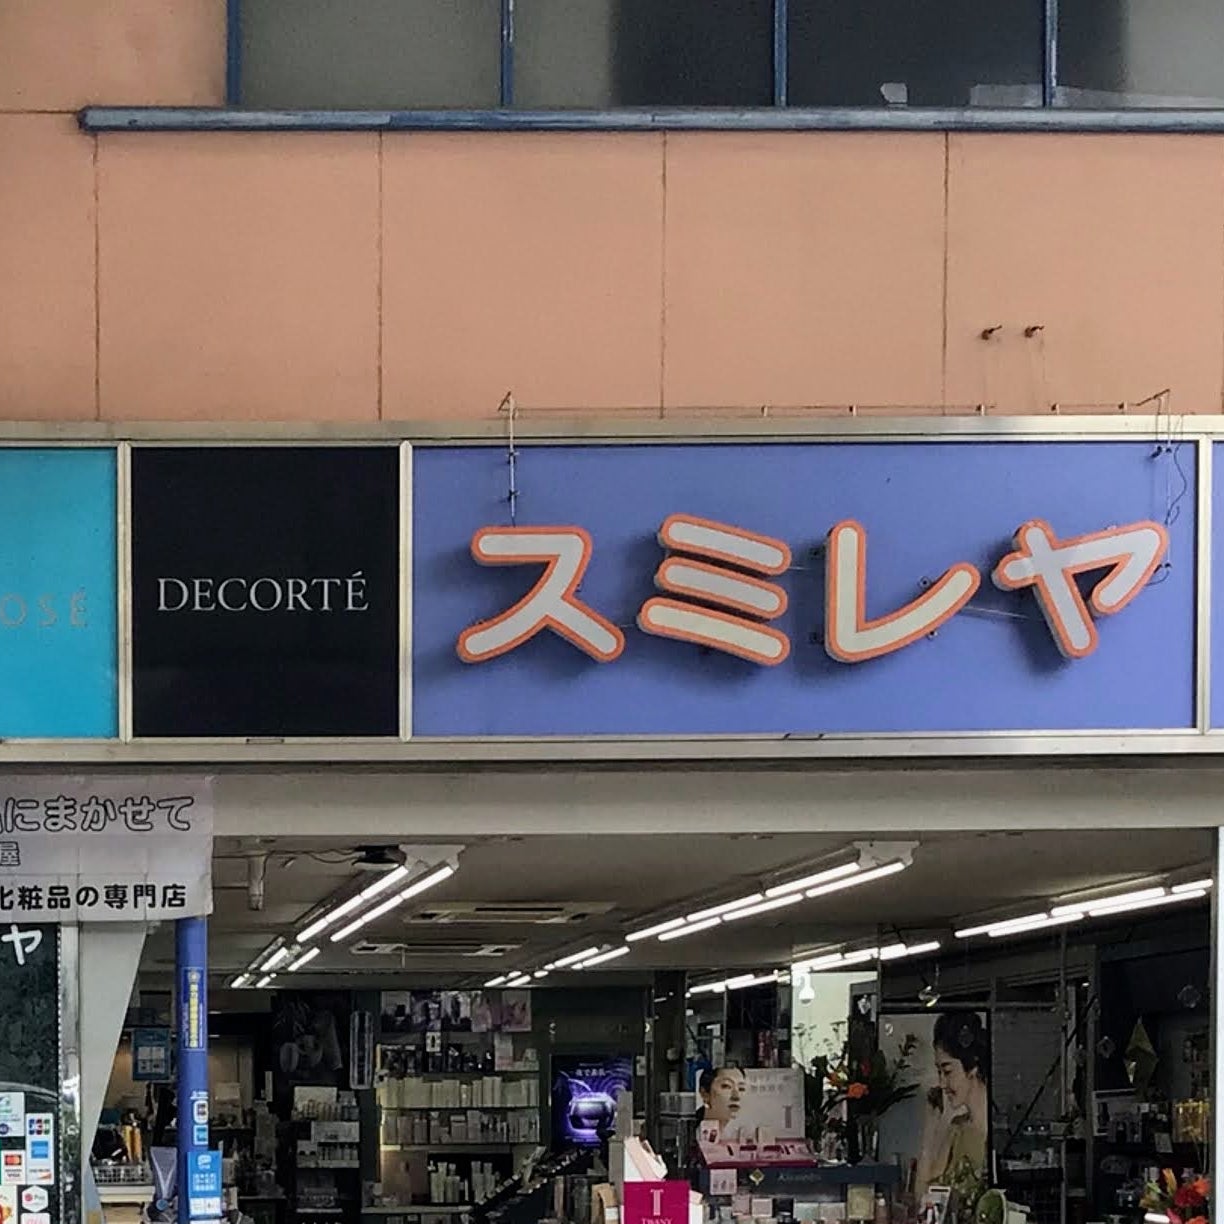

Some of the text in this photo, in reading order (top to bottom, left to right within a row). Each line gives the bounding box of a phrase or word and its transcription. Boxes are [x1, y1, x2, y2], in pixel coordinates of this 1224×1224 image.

[157, 571, 369, 612] DECORTÉ
[456, 513, 1170, 667] スミレヤ
